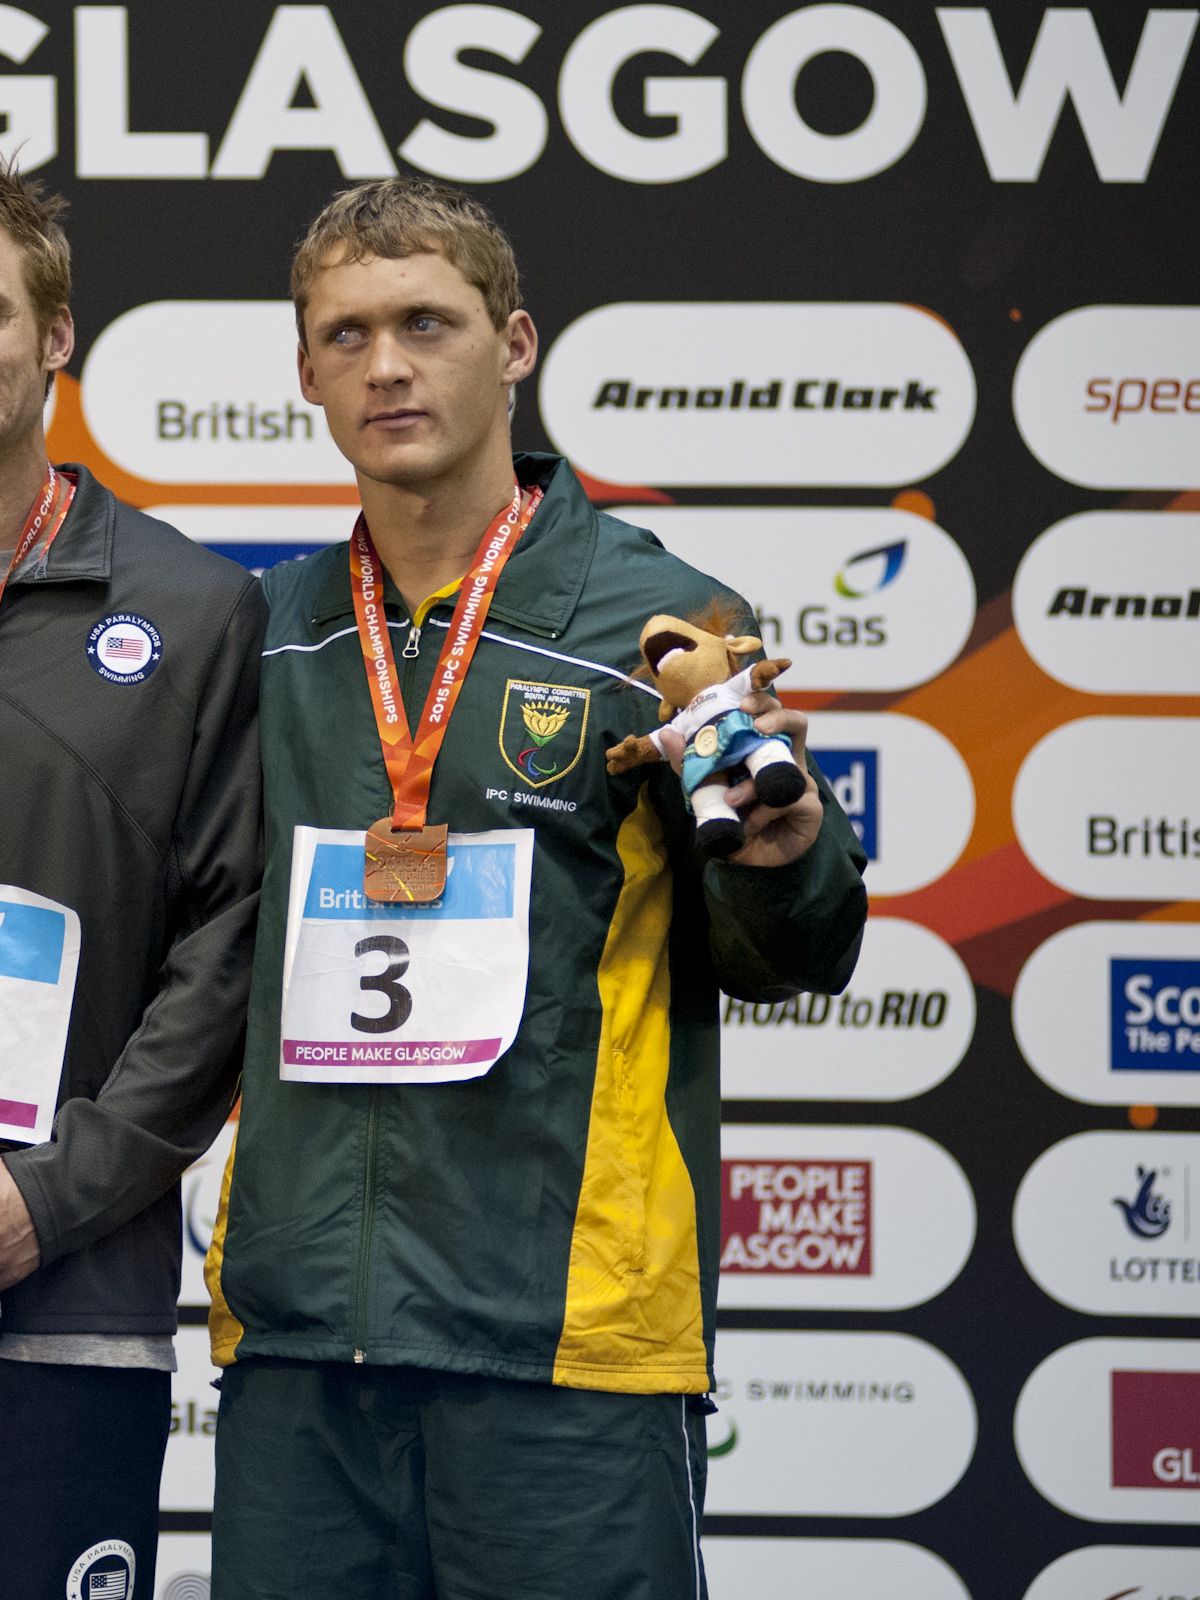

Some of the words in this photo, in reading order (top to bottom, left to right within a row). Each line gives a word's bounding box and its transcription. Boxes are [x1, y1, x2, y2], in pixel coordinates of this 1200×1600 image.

[591, 378, 784, 410] Arnold
[792, 378, 940, 411] Clark
[157, 402, 314, 439] British
[14, 515, 42, 564] WORLD
[359, 554, 376, 602] WORLD
[90, 623, 106, 641] USA
[105, 615, 161, 648] PARALYMPICS
[429, 688, 451, 723] 2015
[441, 658, 460, 685] IPC
[451, 574, 488, 657] SWIMMING
[479, 523, 512, 573] WORLD
[796, 606, 888, 647] Gas
[98, 667, 145, 684] SWIMMING
[364, 603, 398, 724] CHAMPIONSHIPS
[509, 683, 550, 695] PARALYMPIC
[551, 688, 587, 700] COMMITTEE
[524, 691, 546, 701] SOUTH
[547, 695, 571, 705] AFRICA
[485, 788, 508, 800] IPC
[513, 792, 578, 813] SWIMMING
[319, 888, 394, 910] Brit
[350, 934, 413, 1035] 3
[723, 992, 832, 1027] ROAD
[839, 993, 874, 1027] to
[879, 991, 949, 1028] RIO
[295, 1045, 348, 1061] PEOPLE
[351, 1046, 393, 1061] MAKE
[394, 1045, 467, 1061] GLASGOW
[1124, 1026, 1172, 1054] The
[729, 1165, 866, 1201] PEOPLE
[758, 1200, 866, 1235] MAKE
[1109, 1257, 1200, 1282] LOTTE
[747, 1379, 916, 1403] SWIMMING
[1152, 1446, 1200, 1483] GL
[71, 1562, 86, 1583] USA
